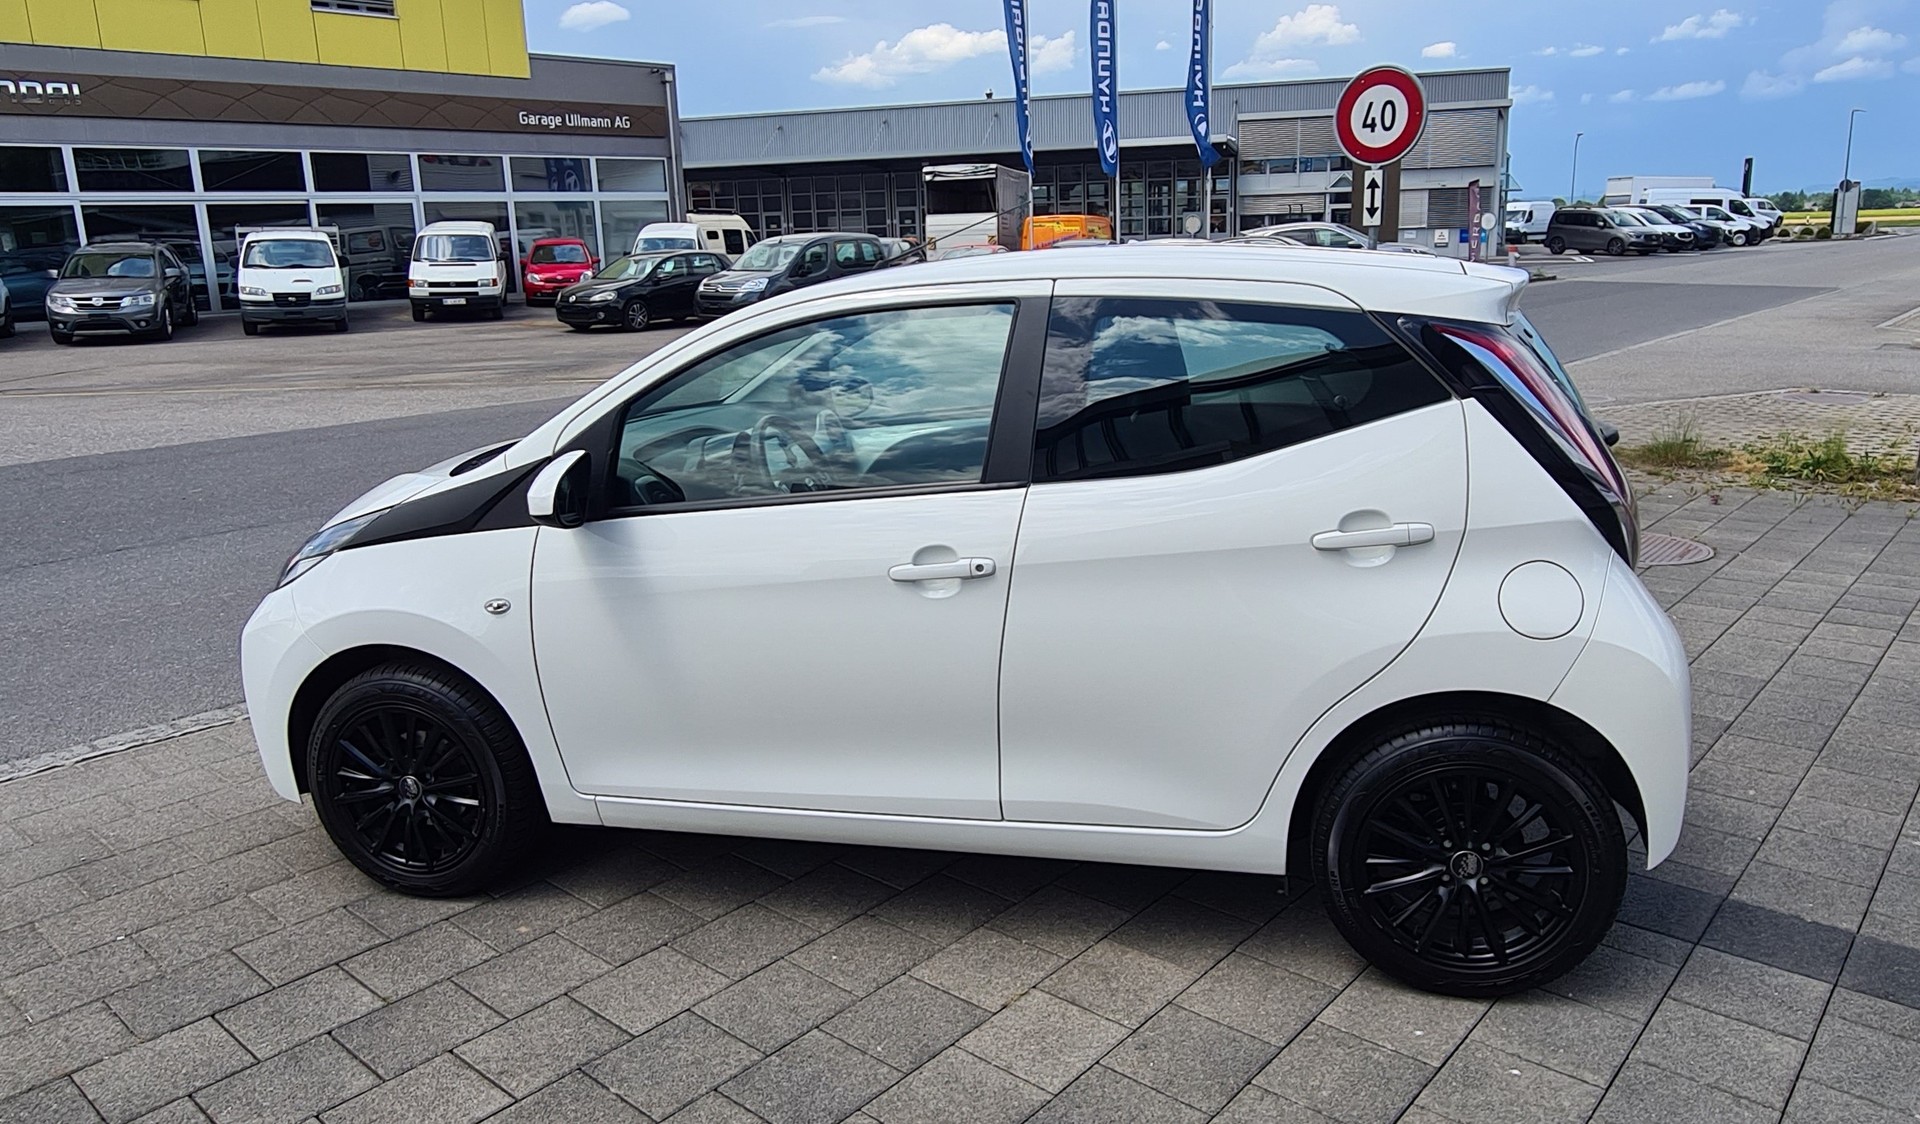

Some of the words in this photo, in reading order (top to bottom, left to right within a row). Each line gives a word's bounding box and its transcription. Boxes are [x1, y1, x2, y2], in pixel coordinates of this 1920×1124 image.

[519, 111, 562, 129] Garage
[565, 113, 611, 128] Ullmann
[614, 116, 631, 128] AG
[1362, 99, 1397, 133] 40
